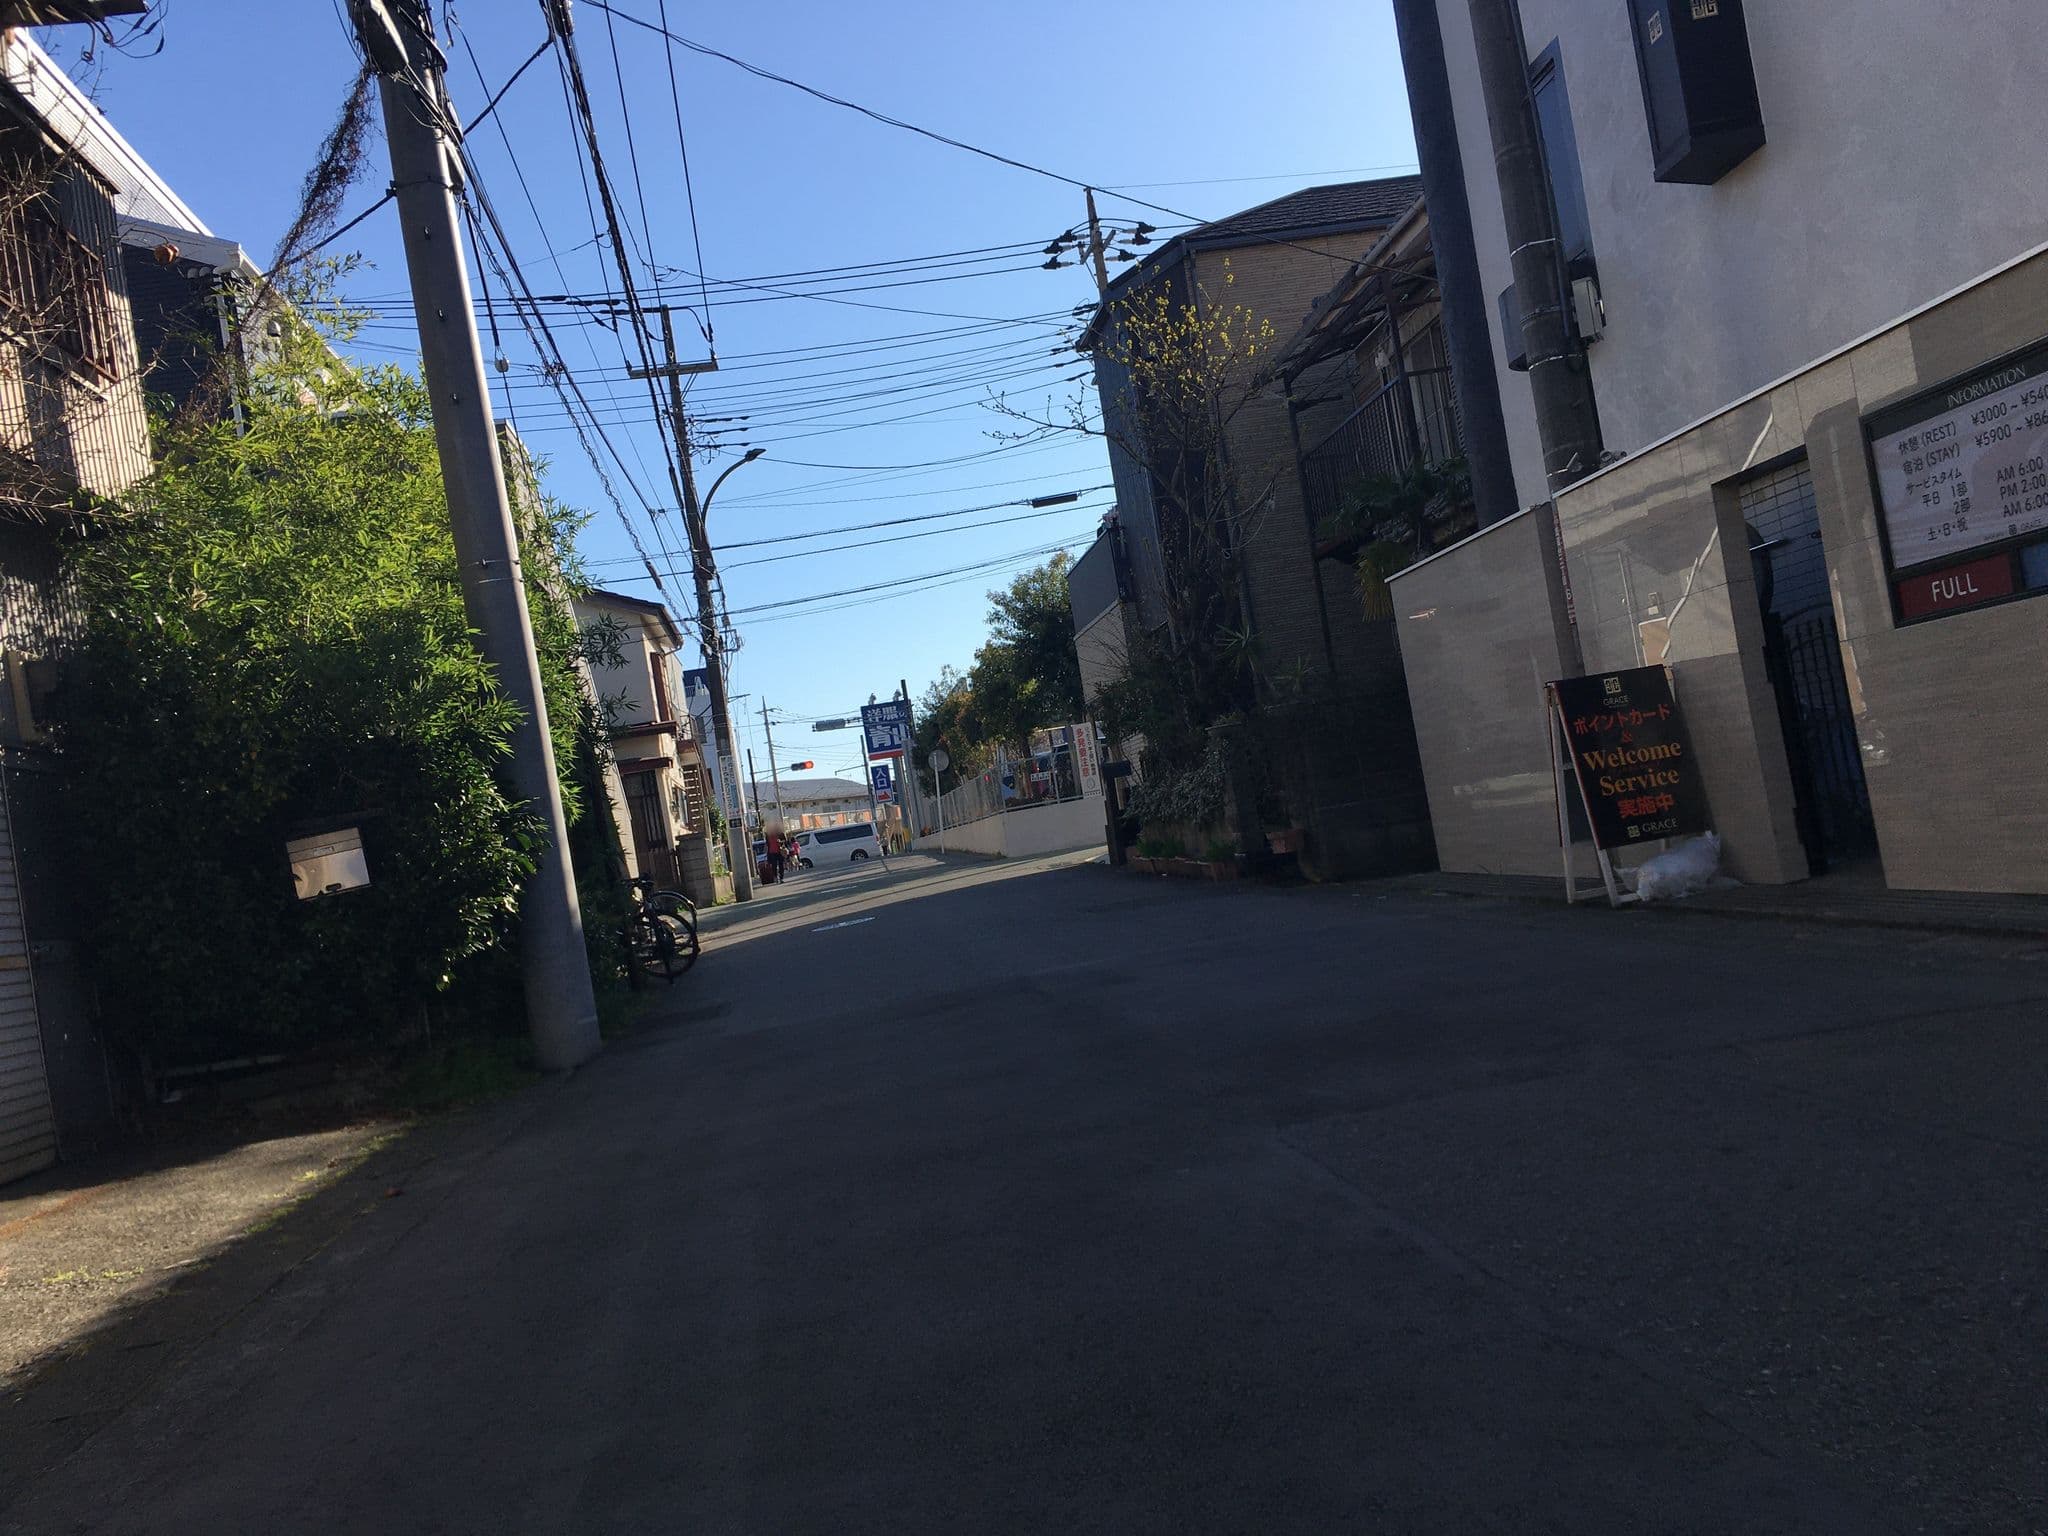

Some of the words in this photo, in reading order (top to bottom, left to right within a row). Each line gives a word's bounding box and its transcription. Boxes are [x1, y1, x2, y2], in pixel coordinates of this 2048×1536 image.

[1947, 364, 2026, 408] INFORMATION
[1898, 435, 1921, 456] 休憩
[1921, 421, 1957, 449] (REST)
[1971, 402, 2007, 427] ¥3000
[1902, 457, 1924, 475] 宿泊
[1925, 443, 1961, 468] (STAY)
[1974, 423, 2011, 449] ¥5900
[1906, 468, 1962, 495] サービスタイム
[1922, 490, 1940, 507] 平日
[1997, 464, 2015, 483] AM
[2018, 456, 2044, 476] 6:00
[2000, 482, 2018, 501] PM
[2021, 473, 2047, 494] 2:00
[2003, 499, 2022, 519] AM
[1932, 573, 1978, 602] FULL
[1603, 694, 1629, 706] GRACE
[867, 705, 907, 723] 洋服の
[1574, 703, 1671, 735] ポイントカード
[868, 723, 910, 748] 青山
[1621, 732, 1633, 743] &
[1582, 741, 1682, 772] Welcome
[875, 768, 887, 788] 入口
[1599, 767, 1680, 796] Service
[1617, 792, 1675, 819] 実施中
[1642, 818, 1679, 833] GRACE
